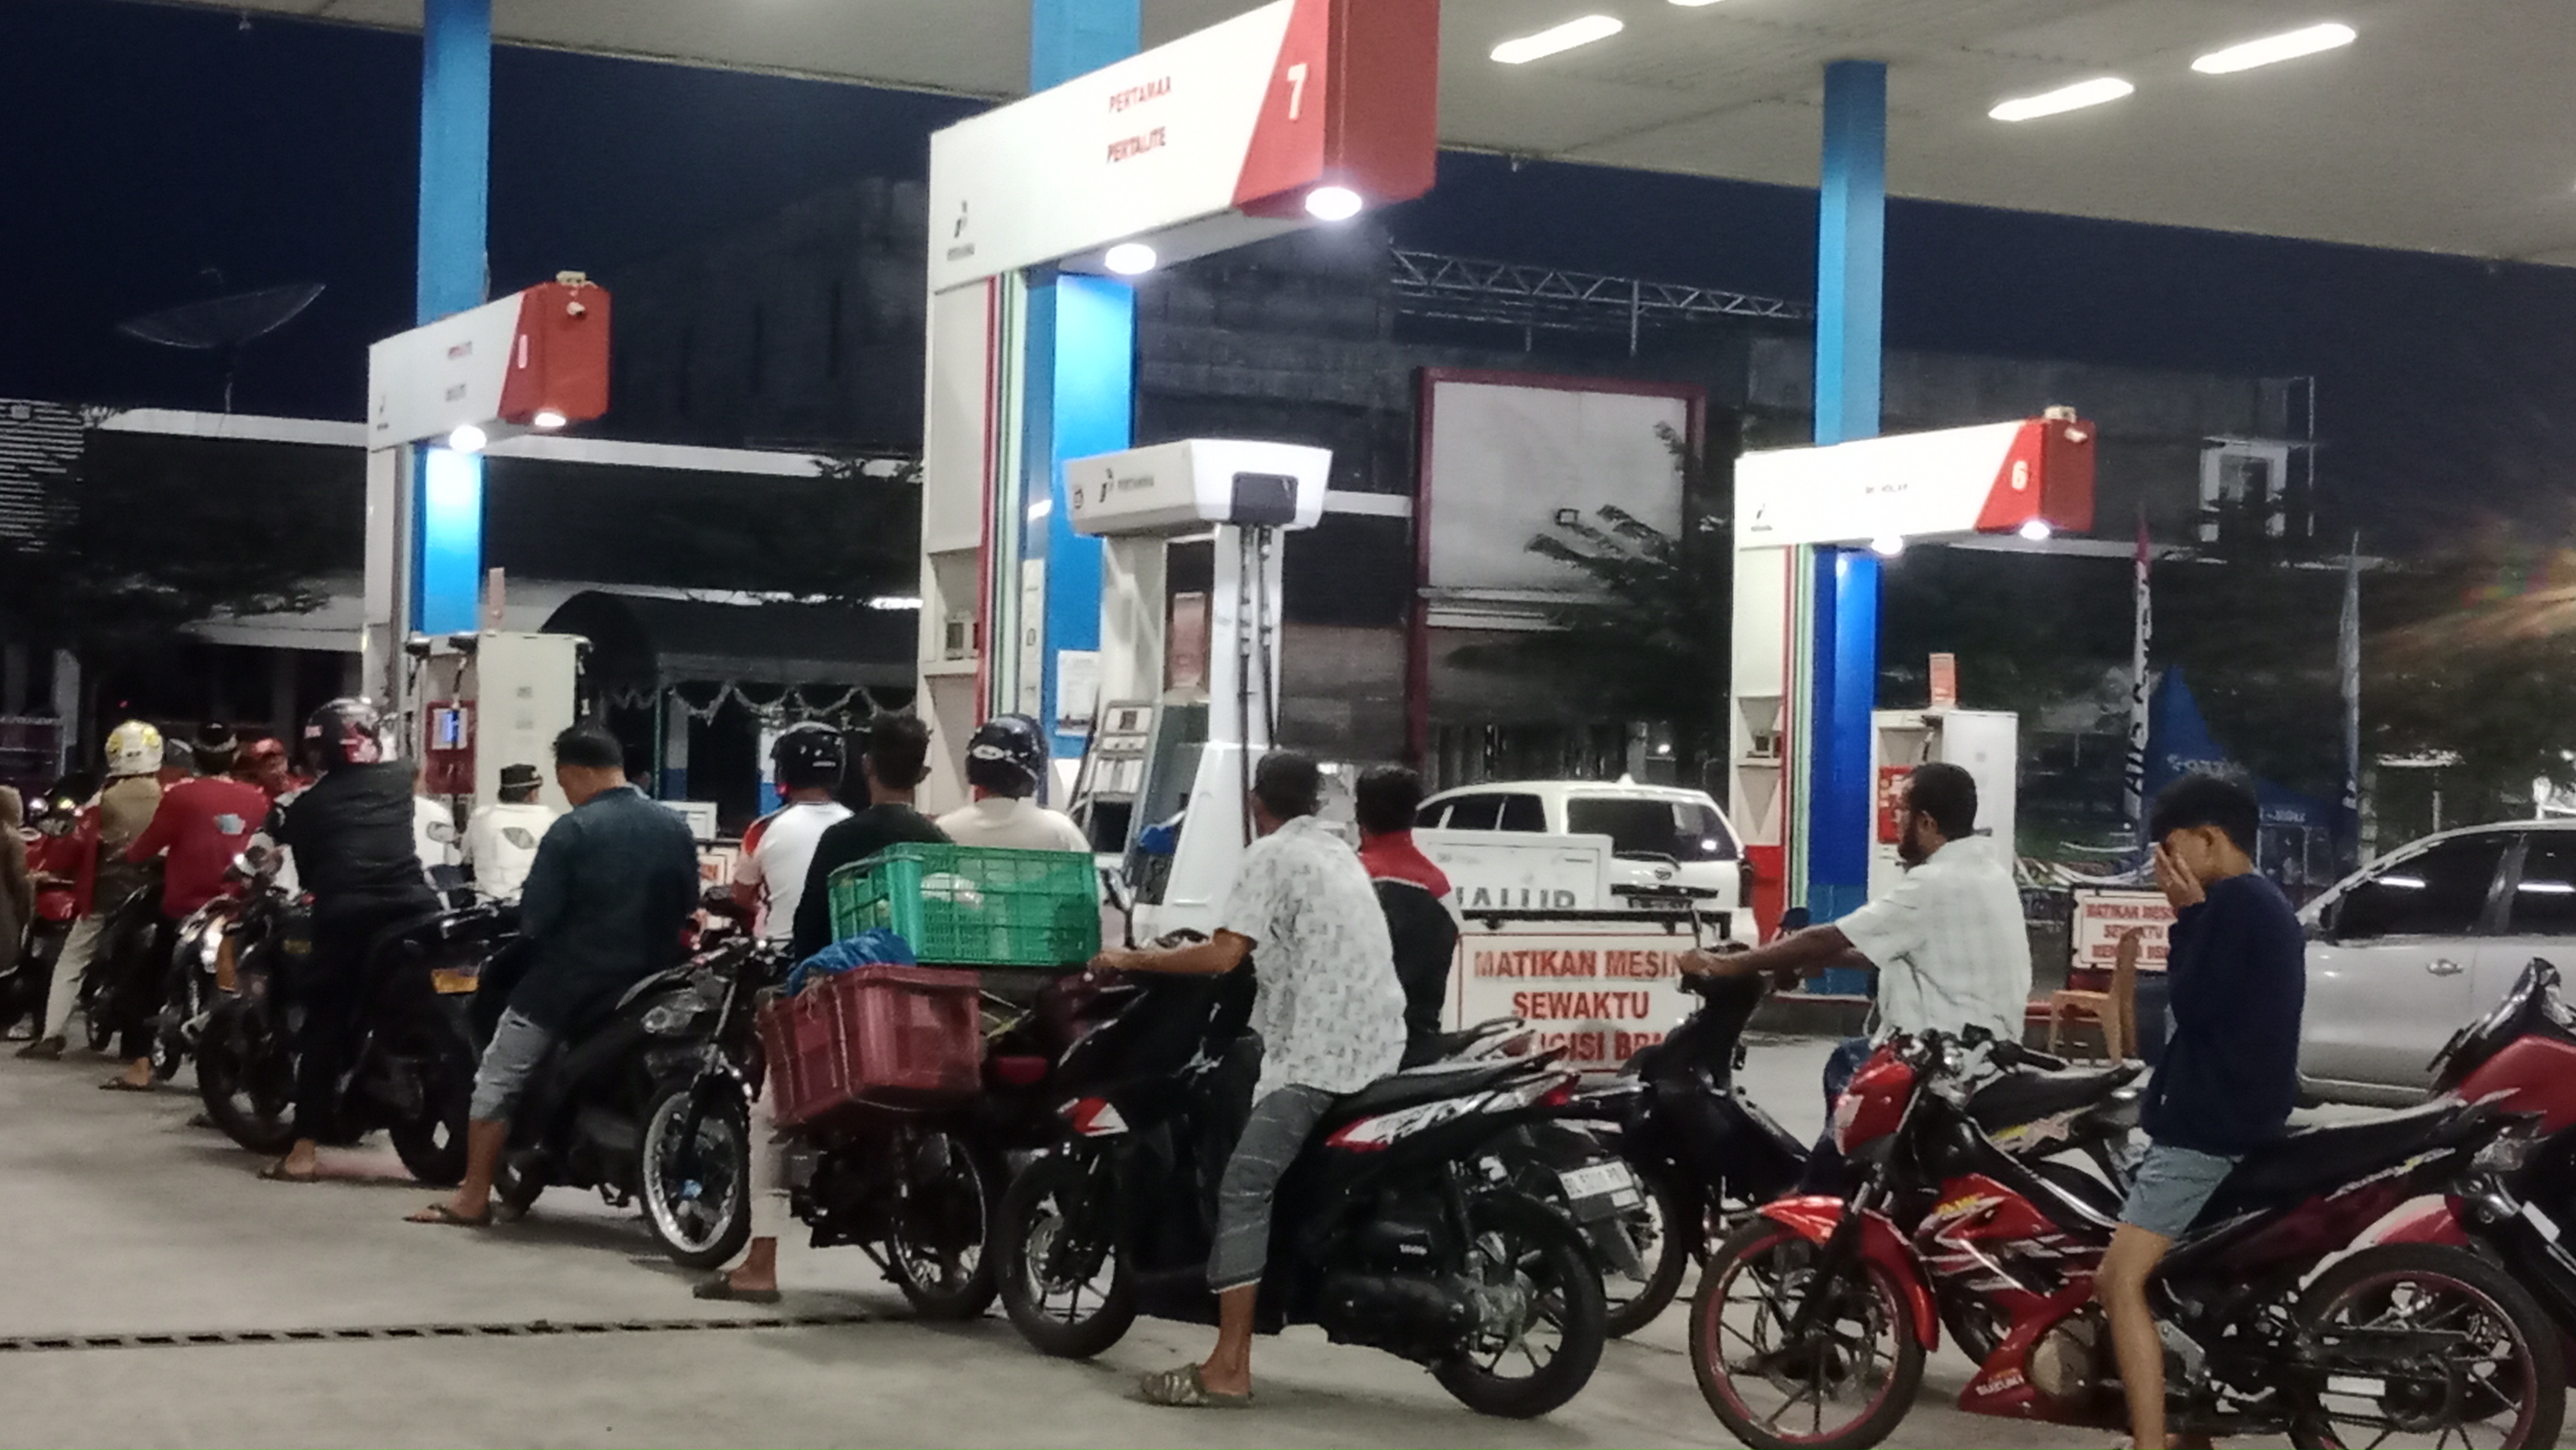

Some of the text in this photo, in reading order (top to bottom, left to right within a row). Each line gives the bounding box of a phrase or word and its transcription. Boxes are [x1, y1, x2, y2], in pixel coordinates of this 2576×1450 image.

[1287, 63, 1308, 121] 7
[1106, 126, 1167, 165] PERTALITE
[2012, 460, 2029, 490] 6
[1474, 950, 1597, 978] MATIKAN
[1512, 991, 1649, 1019] SEWAKTU
[1976, 1375, 2025, 1396] SUZUKI
